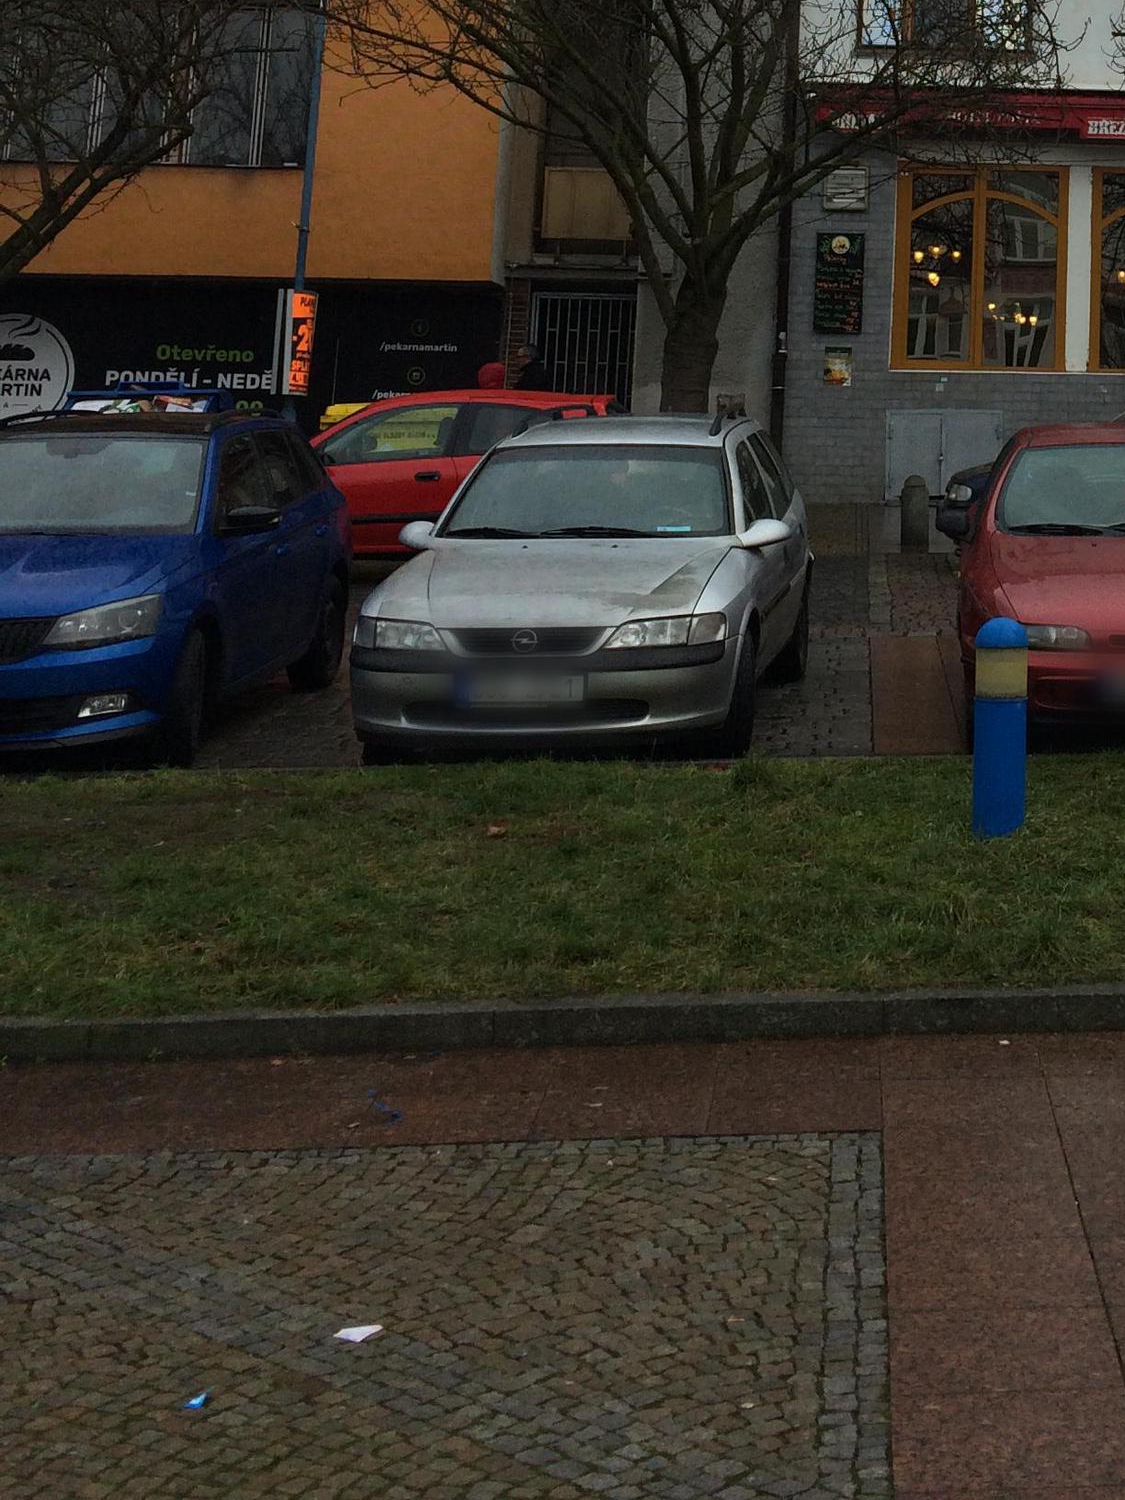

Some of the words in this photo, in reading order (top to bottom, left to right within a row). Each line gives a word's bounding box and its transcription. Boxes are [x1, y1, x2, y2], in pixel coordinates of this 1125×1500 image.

[156, 344, 255, 362] Otevřeno
[379, 341, 458, 353] /pekarnamartin
[0, 365, 51, 381] ÁRNA
[0, 383, 42, 397] RTIN
